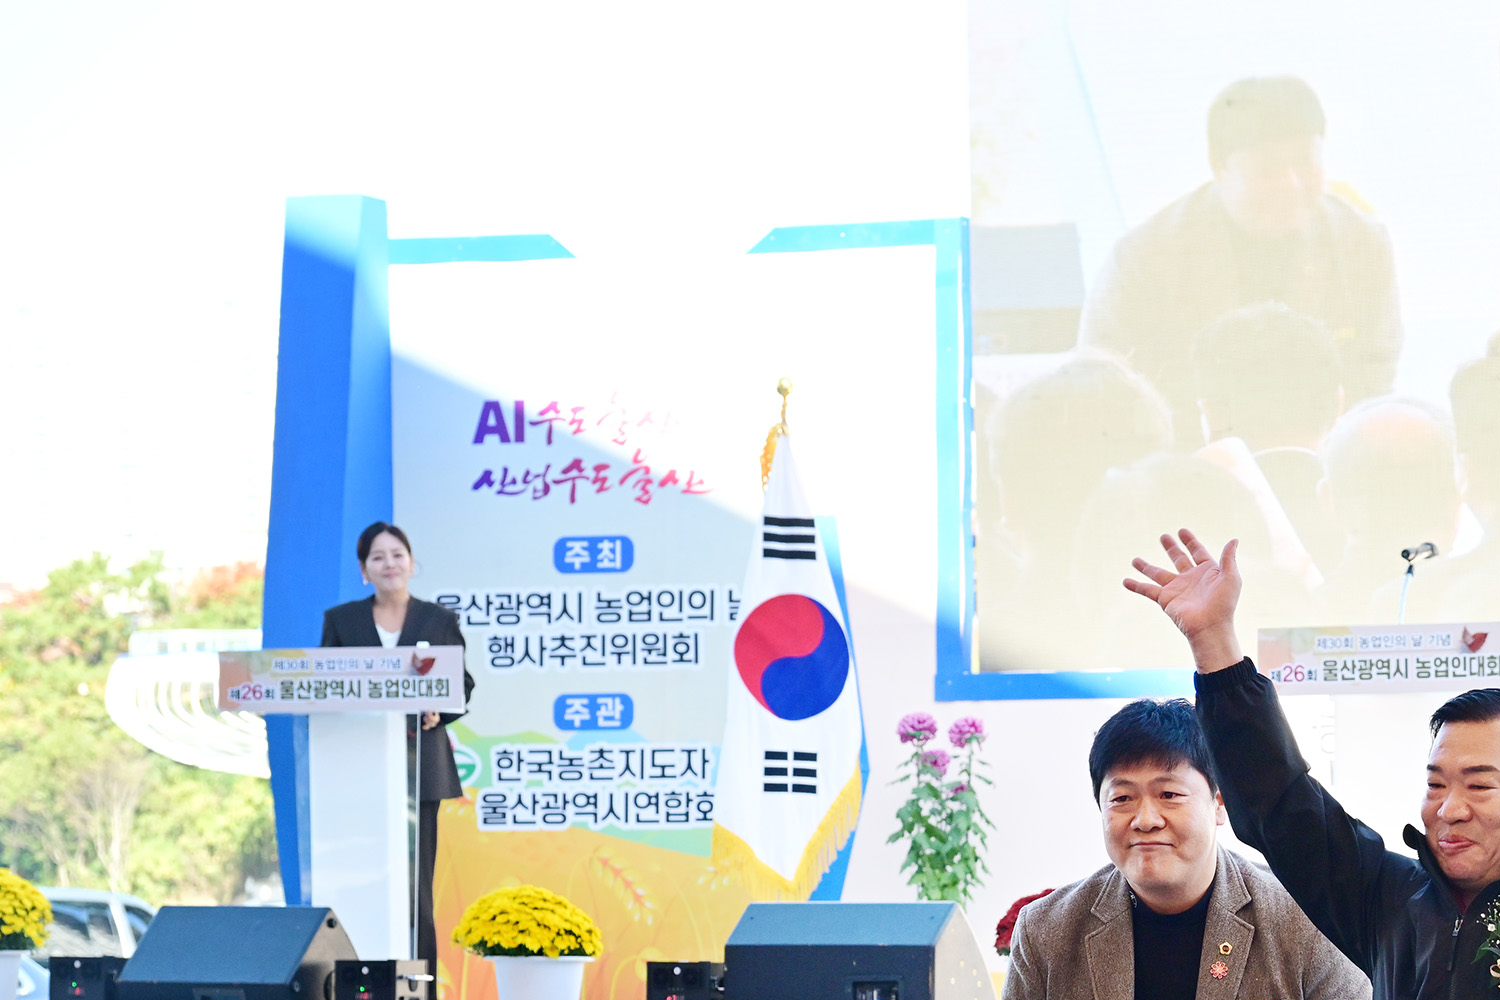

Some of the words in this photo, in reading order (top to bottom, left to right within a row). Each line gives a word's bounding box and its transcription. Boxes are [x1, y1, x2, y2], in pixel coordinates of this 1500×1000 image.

[595, 590, 714, 623] 농업인의
[488, 632, 699, 668] 행사추진위원회
[1317, 636, 1353, 649] 제30회
[1359, 634, 1407, 648] 농업인의
[1412, 634, 1423, 647] 날
[1429, 633, 1451, 647] 기념
[1271, 665, 1318, 683] 제26회
[1323, 658, 1409, 682] 울산광역시
[280, 679, 361, 700] 울산광역시
[368, 678, 450, 698] 농업인대회
[495, 747, 710, 782] 한국농촌지도자
